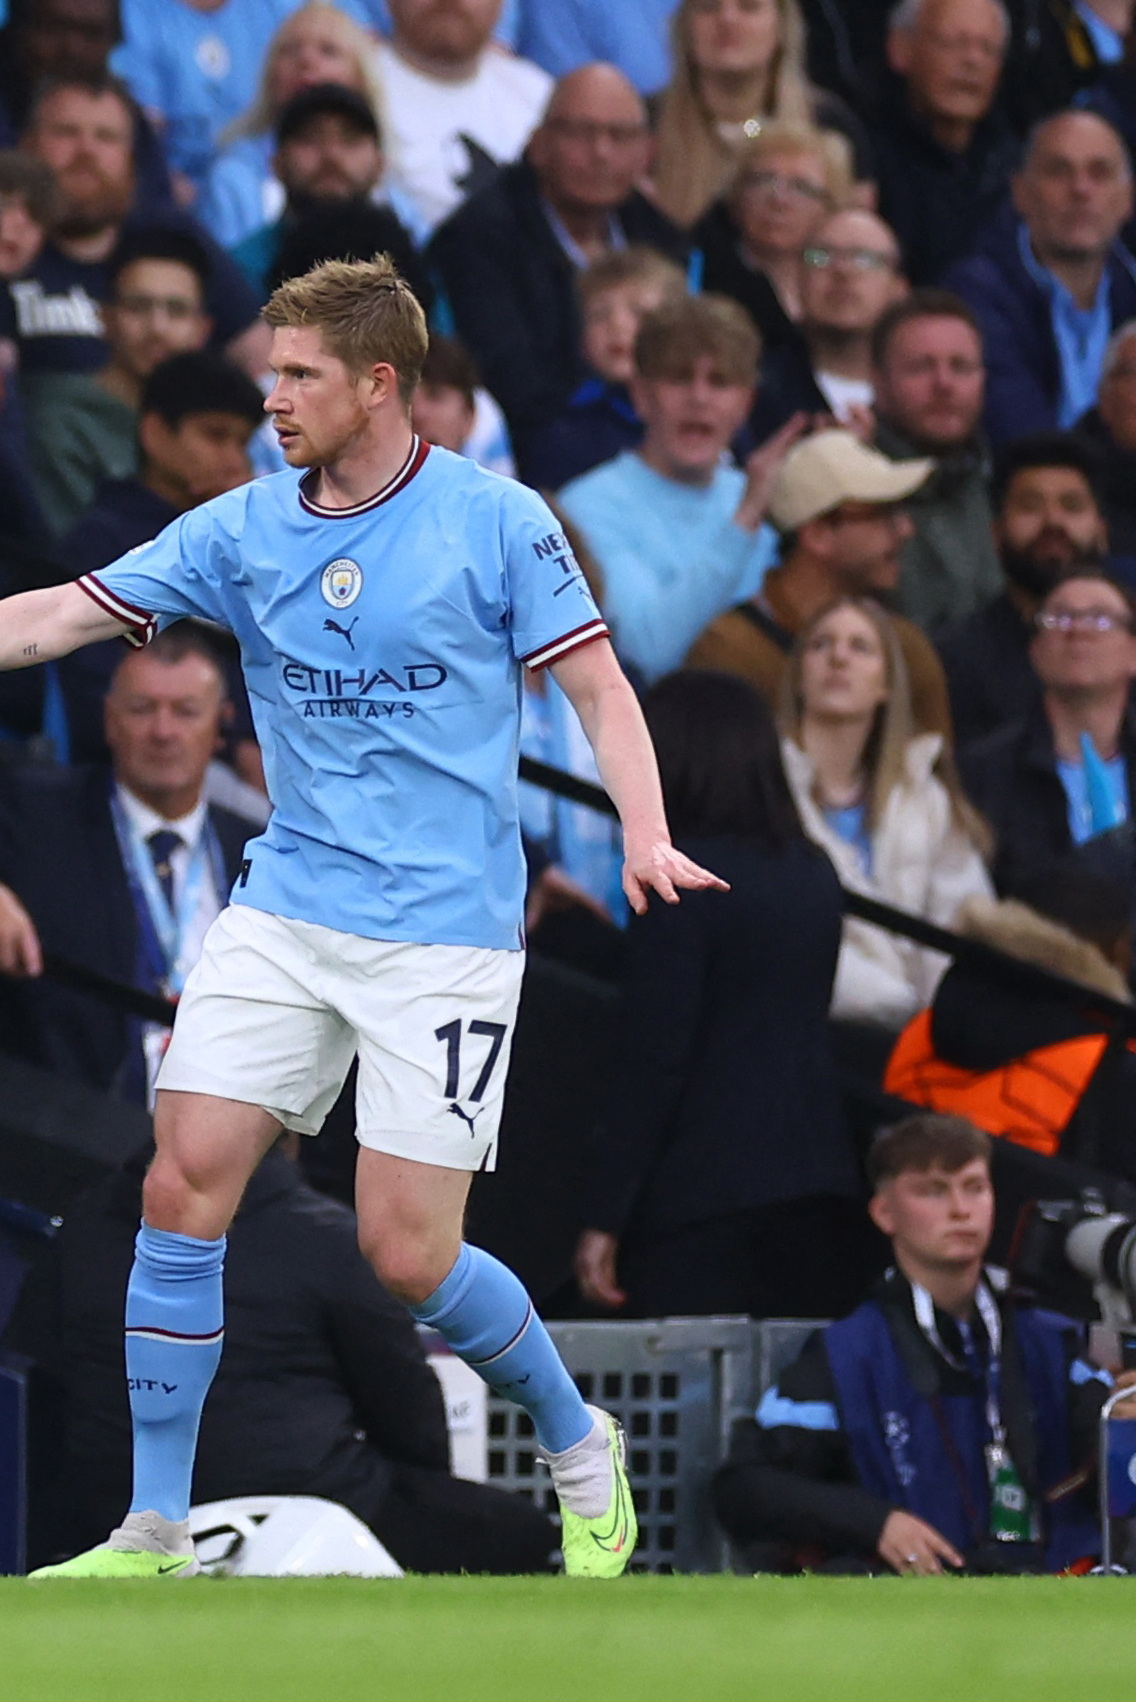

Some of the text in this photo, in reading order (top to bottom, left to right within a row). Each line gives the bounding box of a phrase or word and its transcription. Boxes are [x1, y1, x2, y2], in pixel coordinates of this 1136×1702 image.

[283, 663, 447, 696] ETIHAD
[304, 701, 414, 718] AIRWAYS
[434, 1018, 508, 1102] 17
